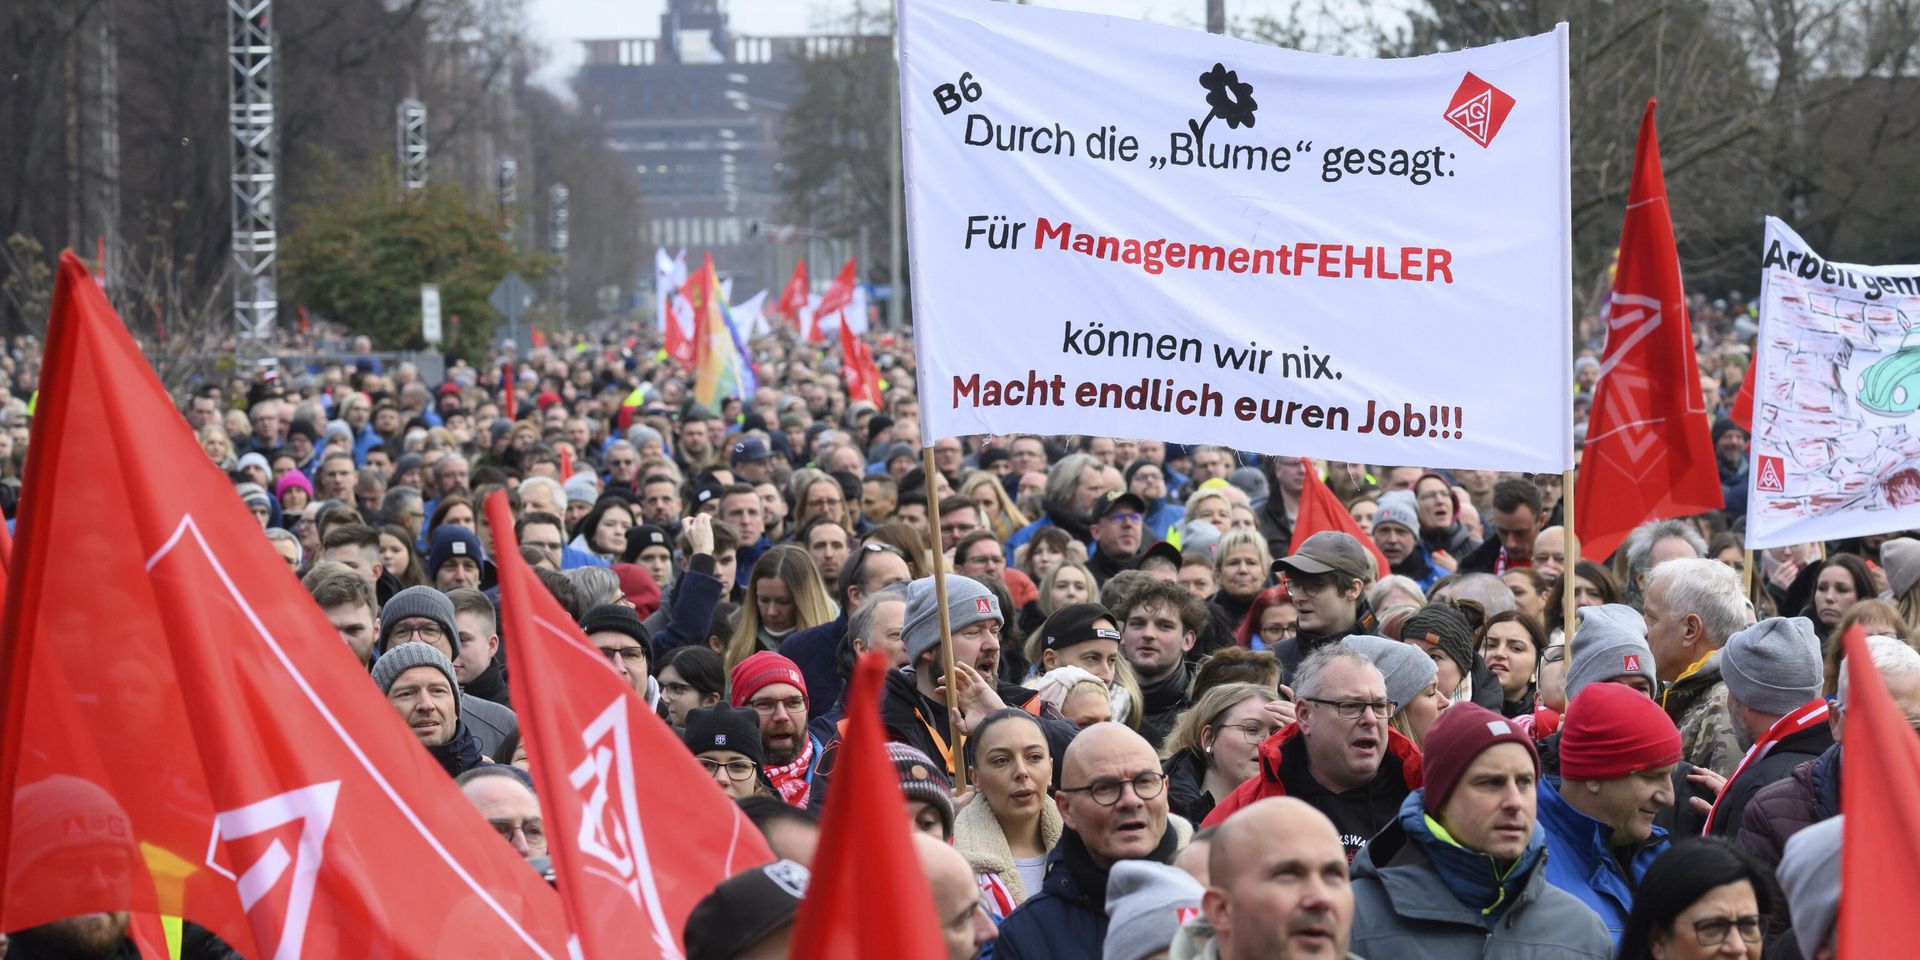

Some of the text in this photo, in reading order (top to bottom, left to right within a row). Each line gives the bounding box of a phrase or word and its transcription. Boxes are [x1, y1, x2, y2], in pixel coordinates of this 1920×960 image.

[932, 71, 983, 116] B6
[964, 113, 1075, 157] Durch
[1085, 125, 1139, 162] die
[1321, 145, 1456, 186] gesagt:
[964, 214, 1454, 284] Für ManagementFEHLER
[1062, 320, 1343, 381] können wir nix.
[952, 369, 1463, 440] Macht endlich euren Job!!!
